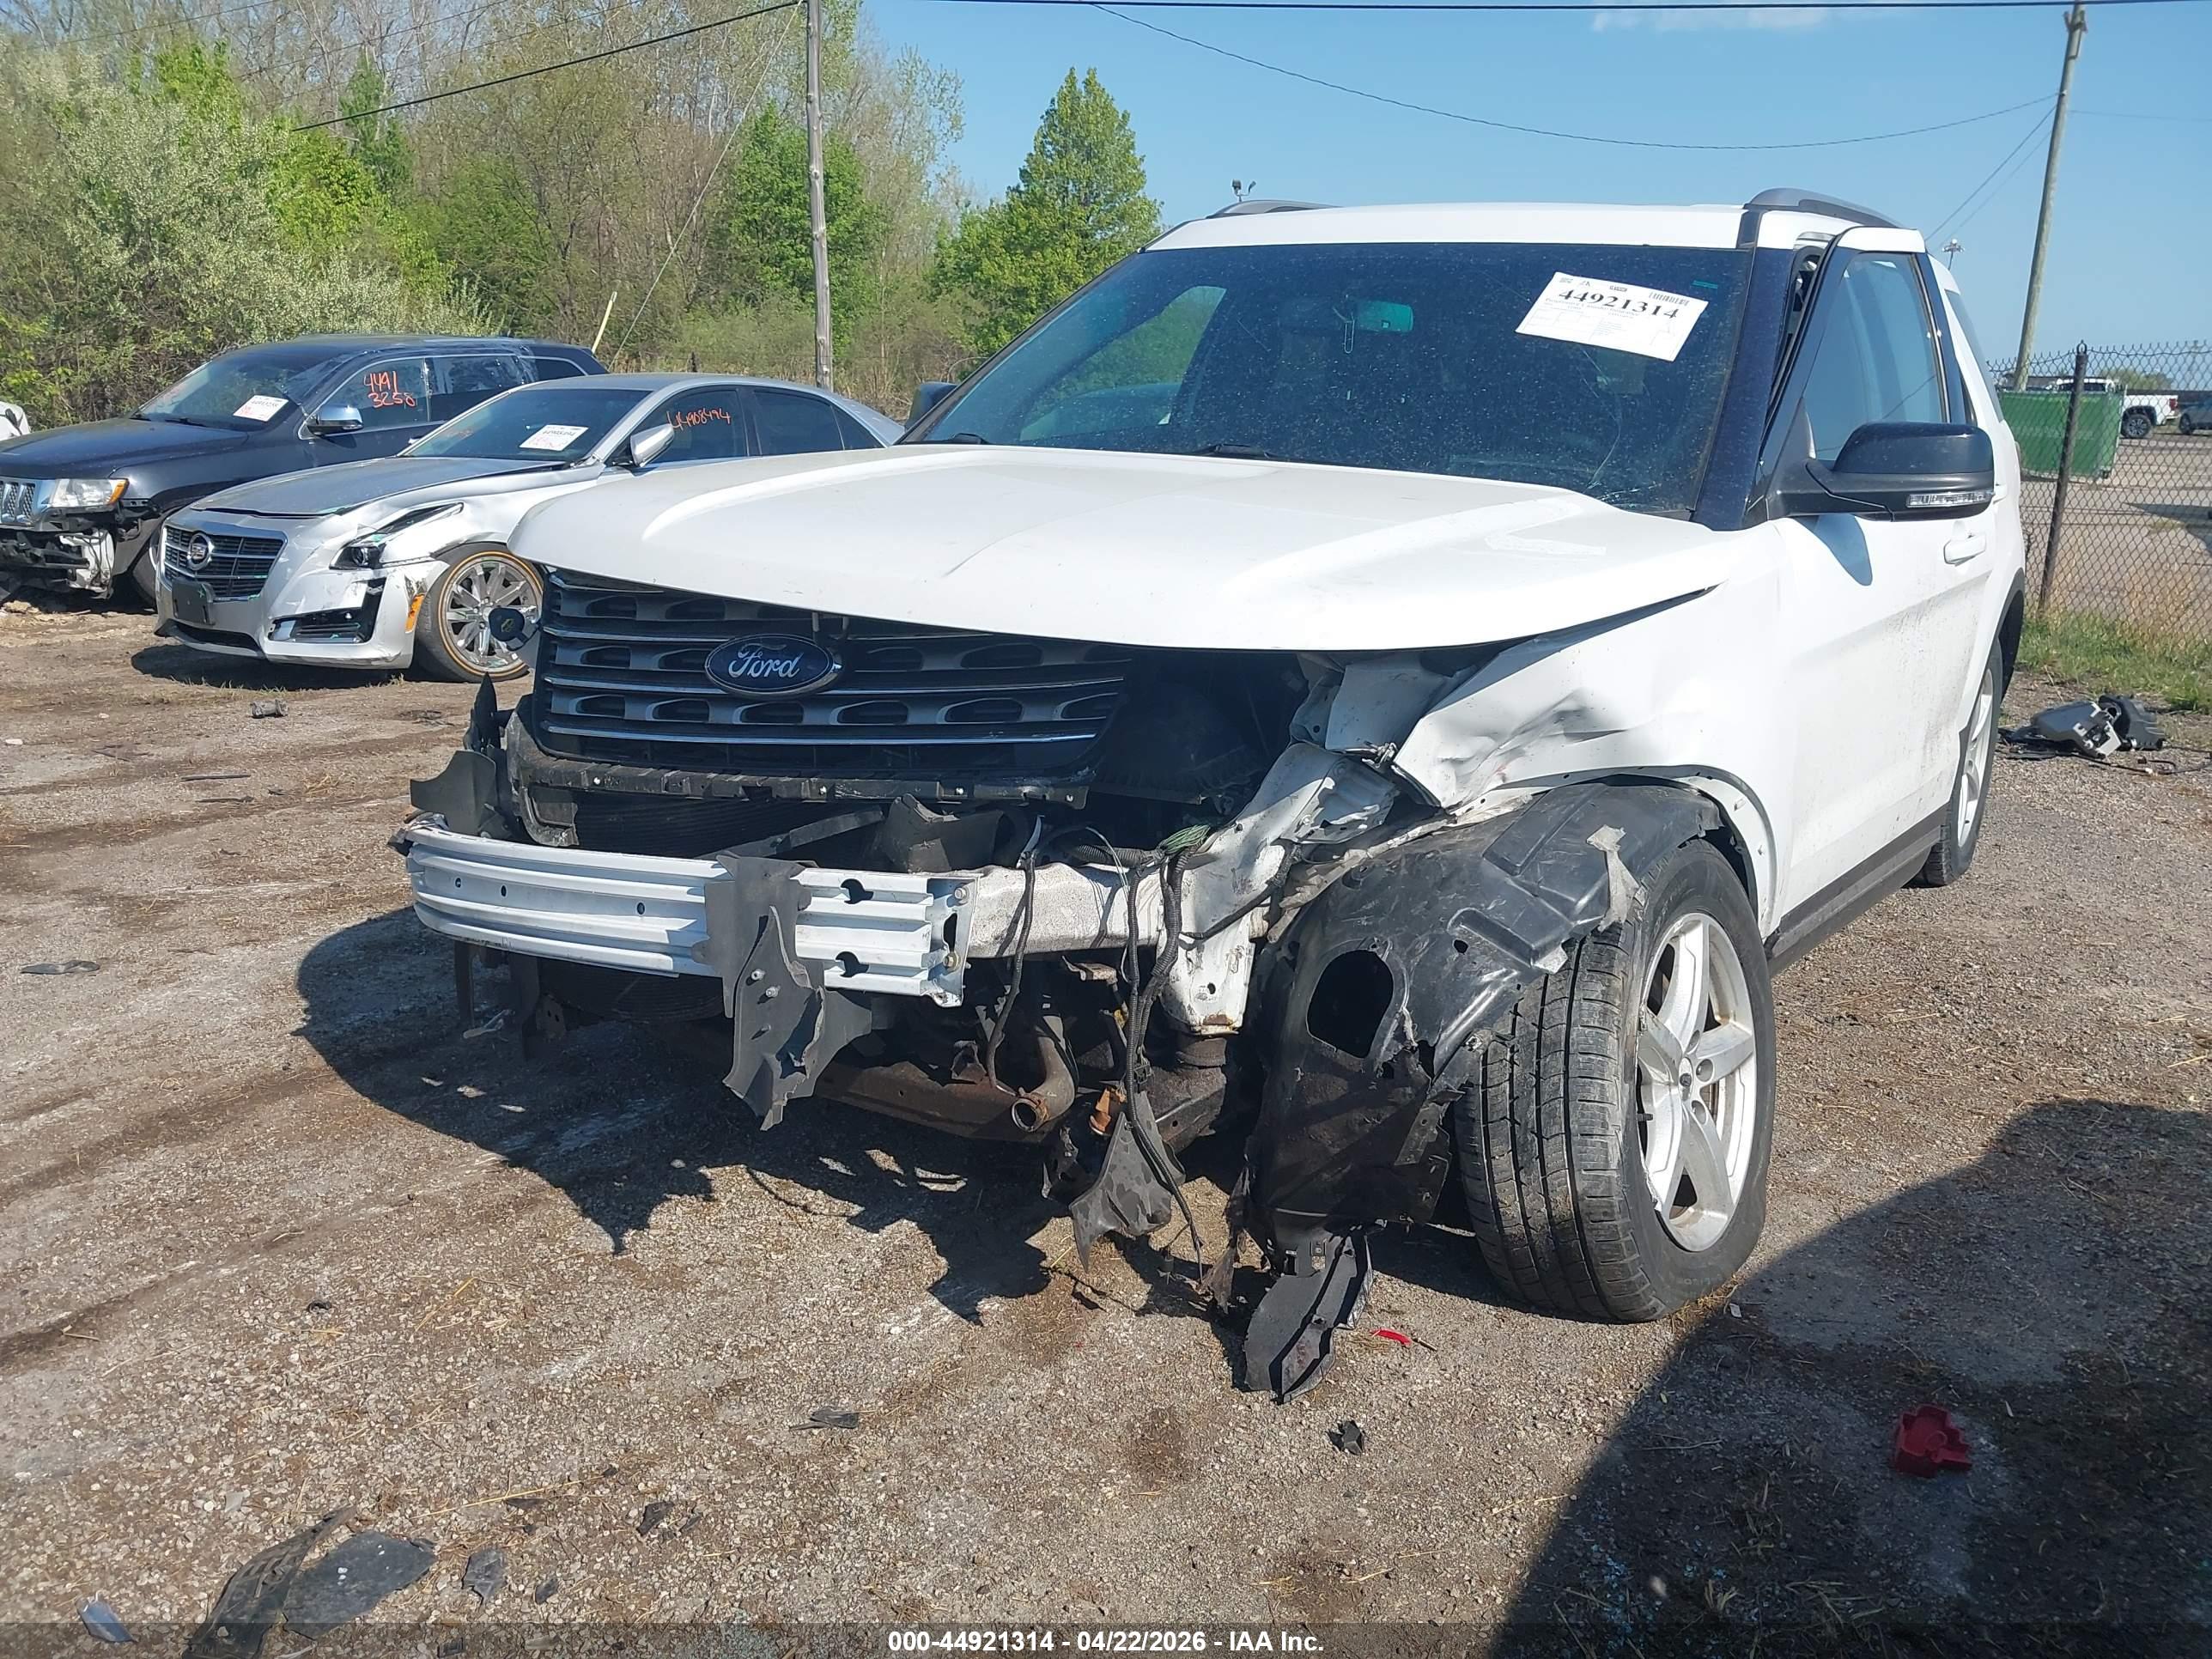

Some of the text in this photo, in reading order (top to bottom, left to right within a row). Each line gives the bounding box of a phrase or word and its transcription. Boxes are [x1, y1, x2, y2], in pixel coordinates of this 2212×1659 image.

[1559, 289, 1680, 319] 44921314
[363, 370, 398, 392] 4491
[728, 643, 805, 678] Ford
